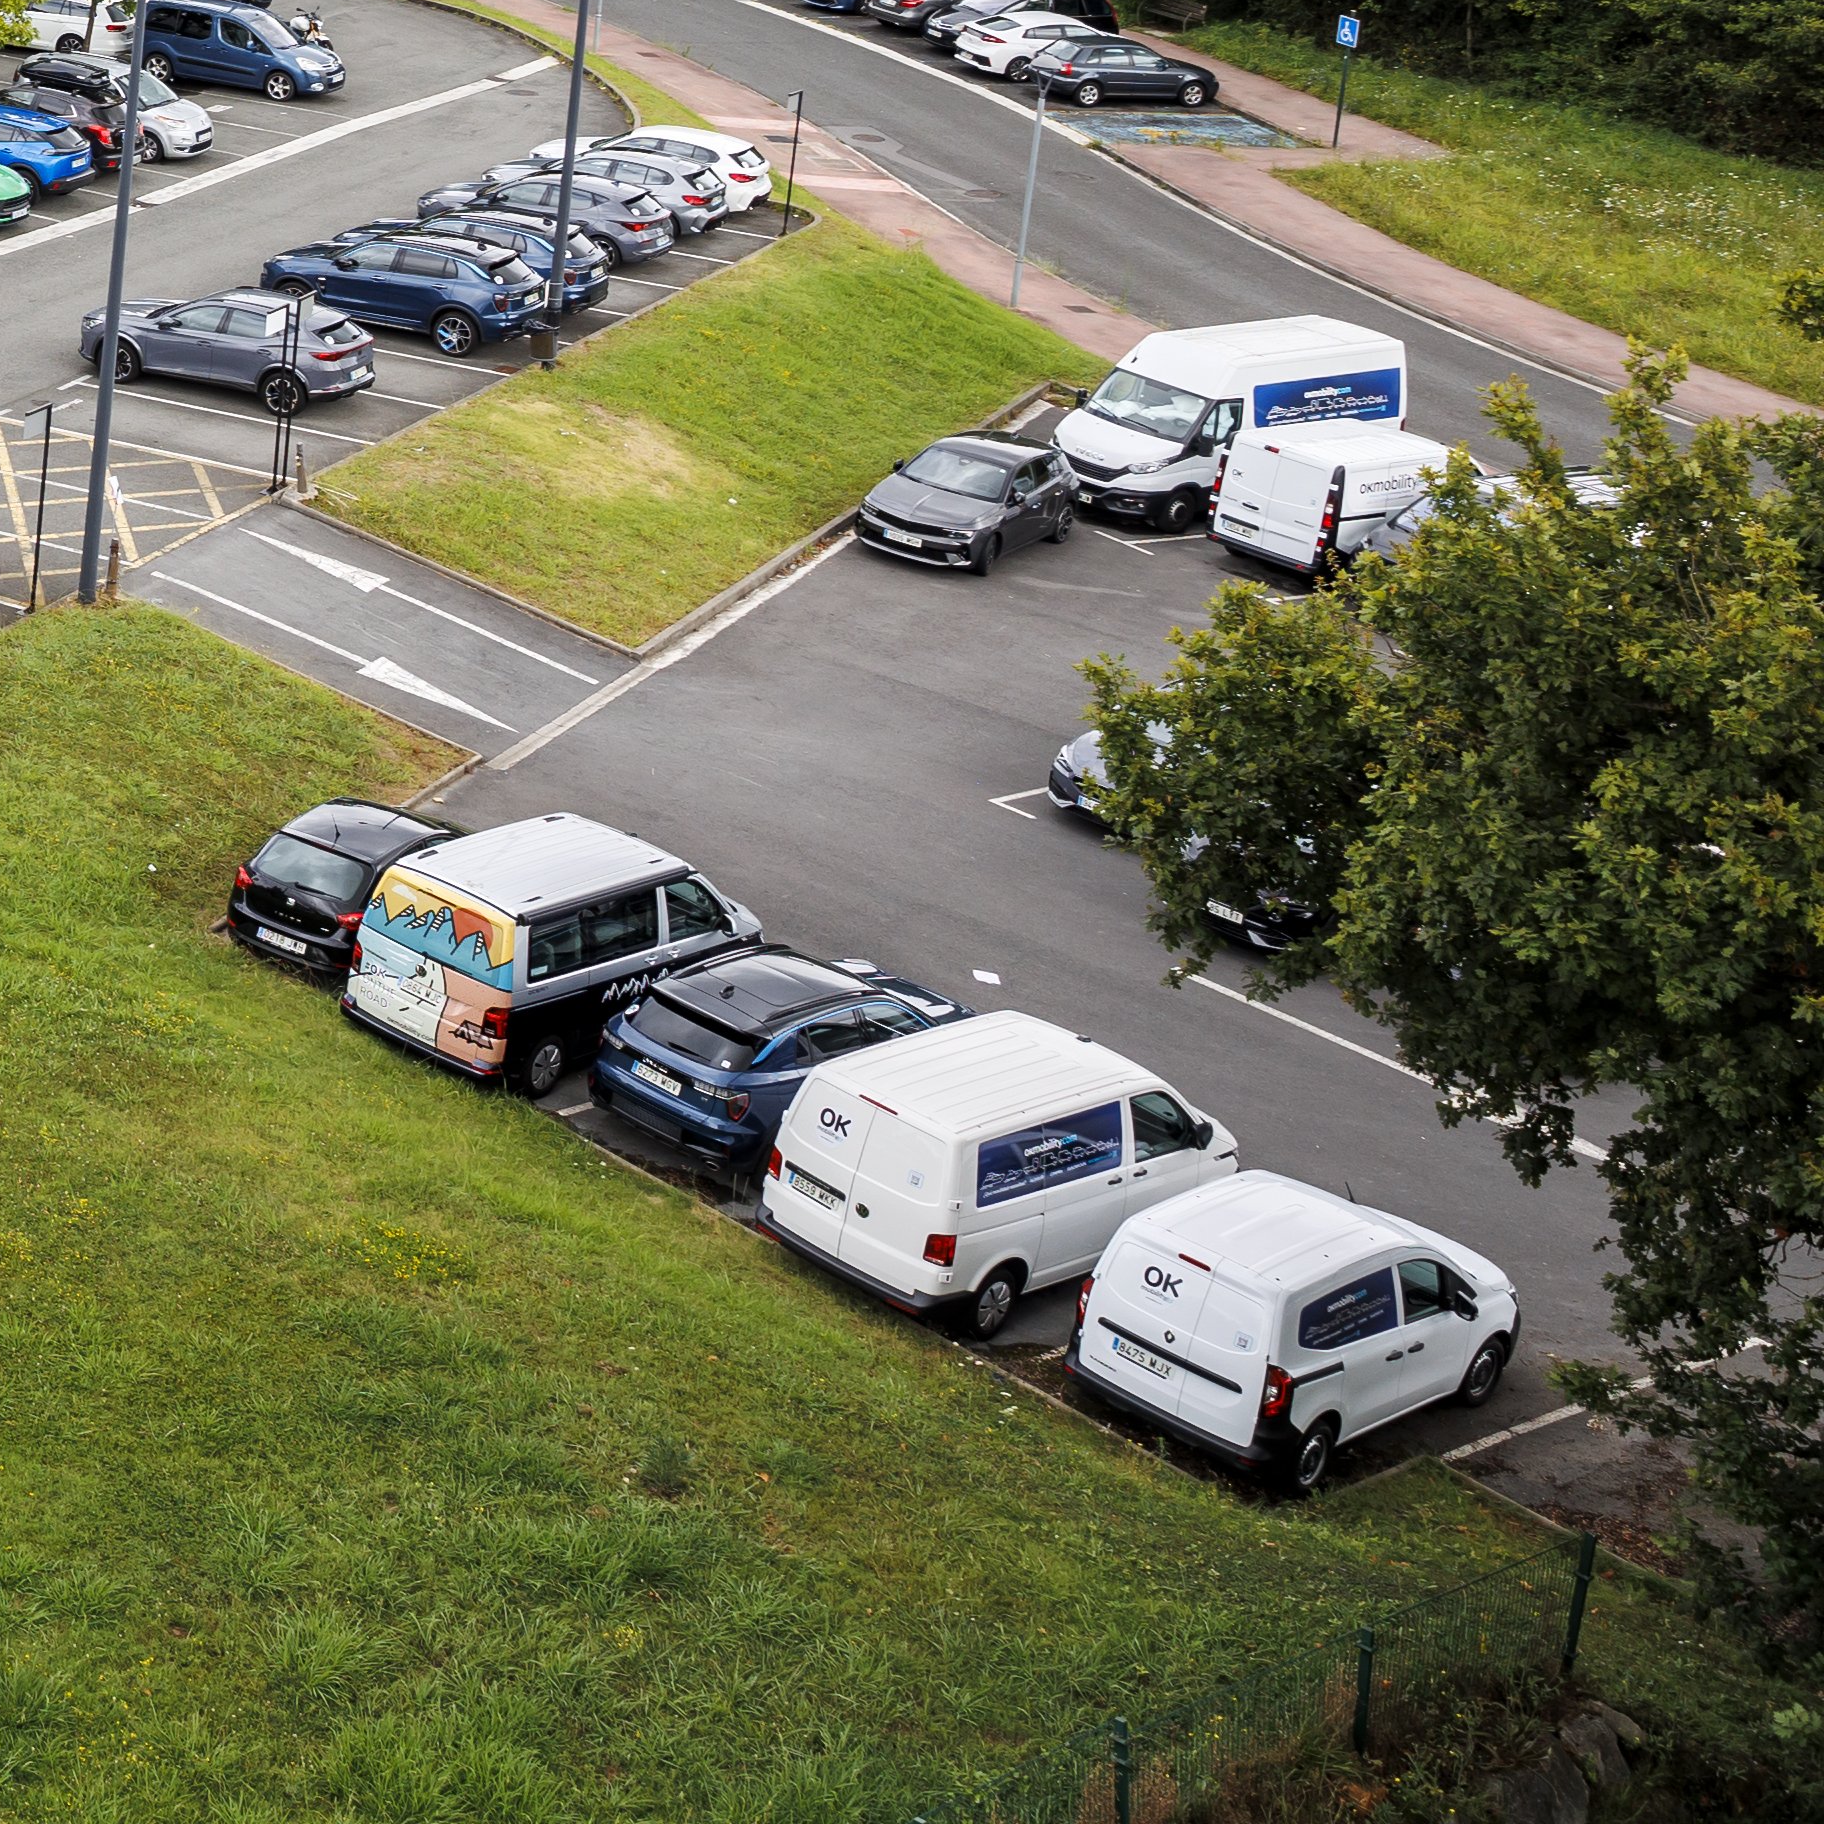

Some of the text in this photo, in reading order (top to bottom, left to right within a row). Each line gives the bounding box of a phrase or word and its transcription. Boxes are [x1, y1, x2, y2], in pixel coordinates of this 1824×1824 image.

[360, 986, 388, 1008] ROAD
[820, 1107, 852, 1137] OK
[1144, 1265, 1183, 1298] OK
[1118, 1342, 1146, 1363] 8475
[1149, 1356, 1172, 1377] MJX
